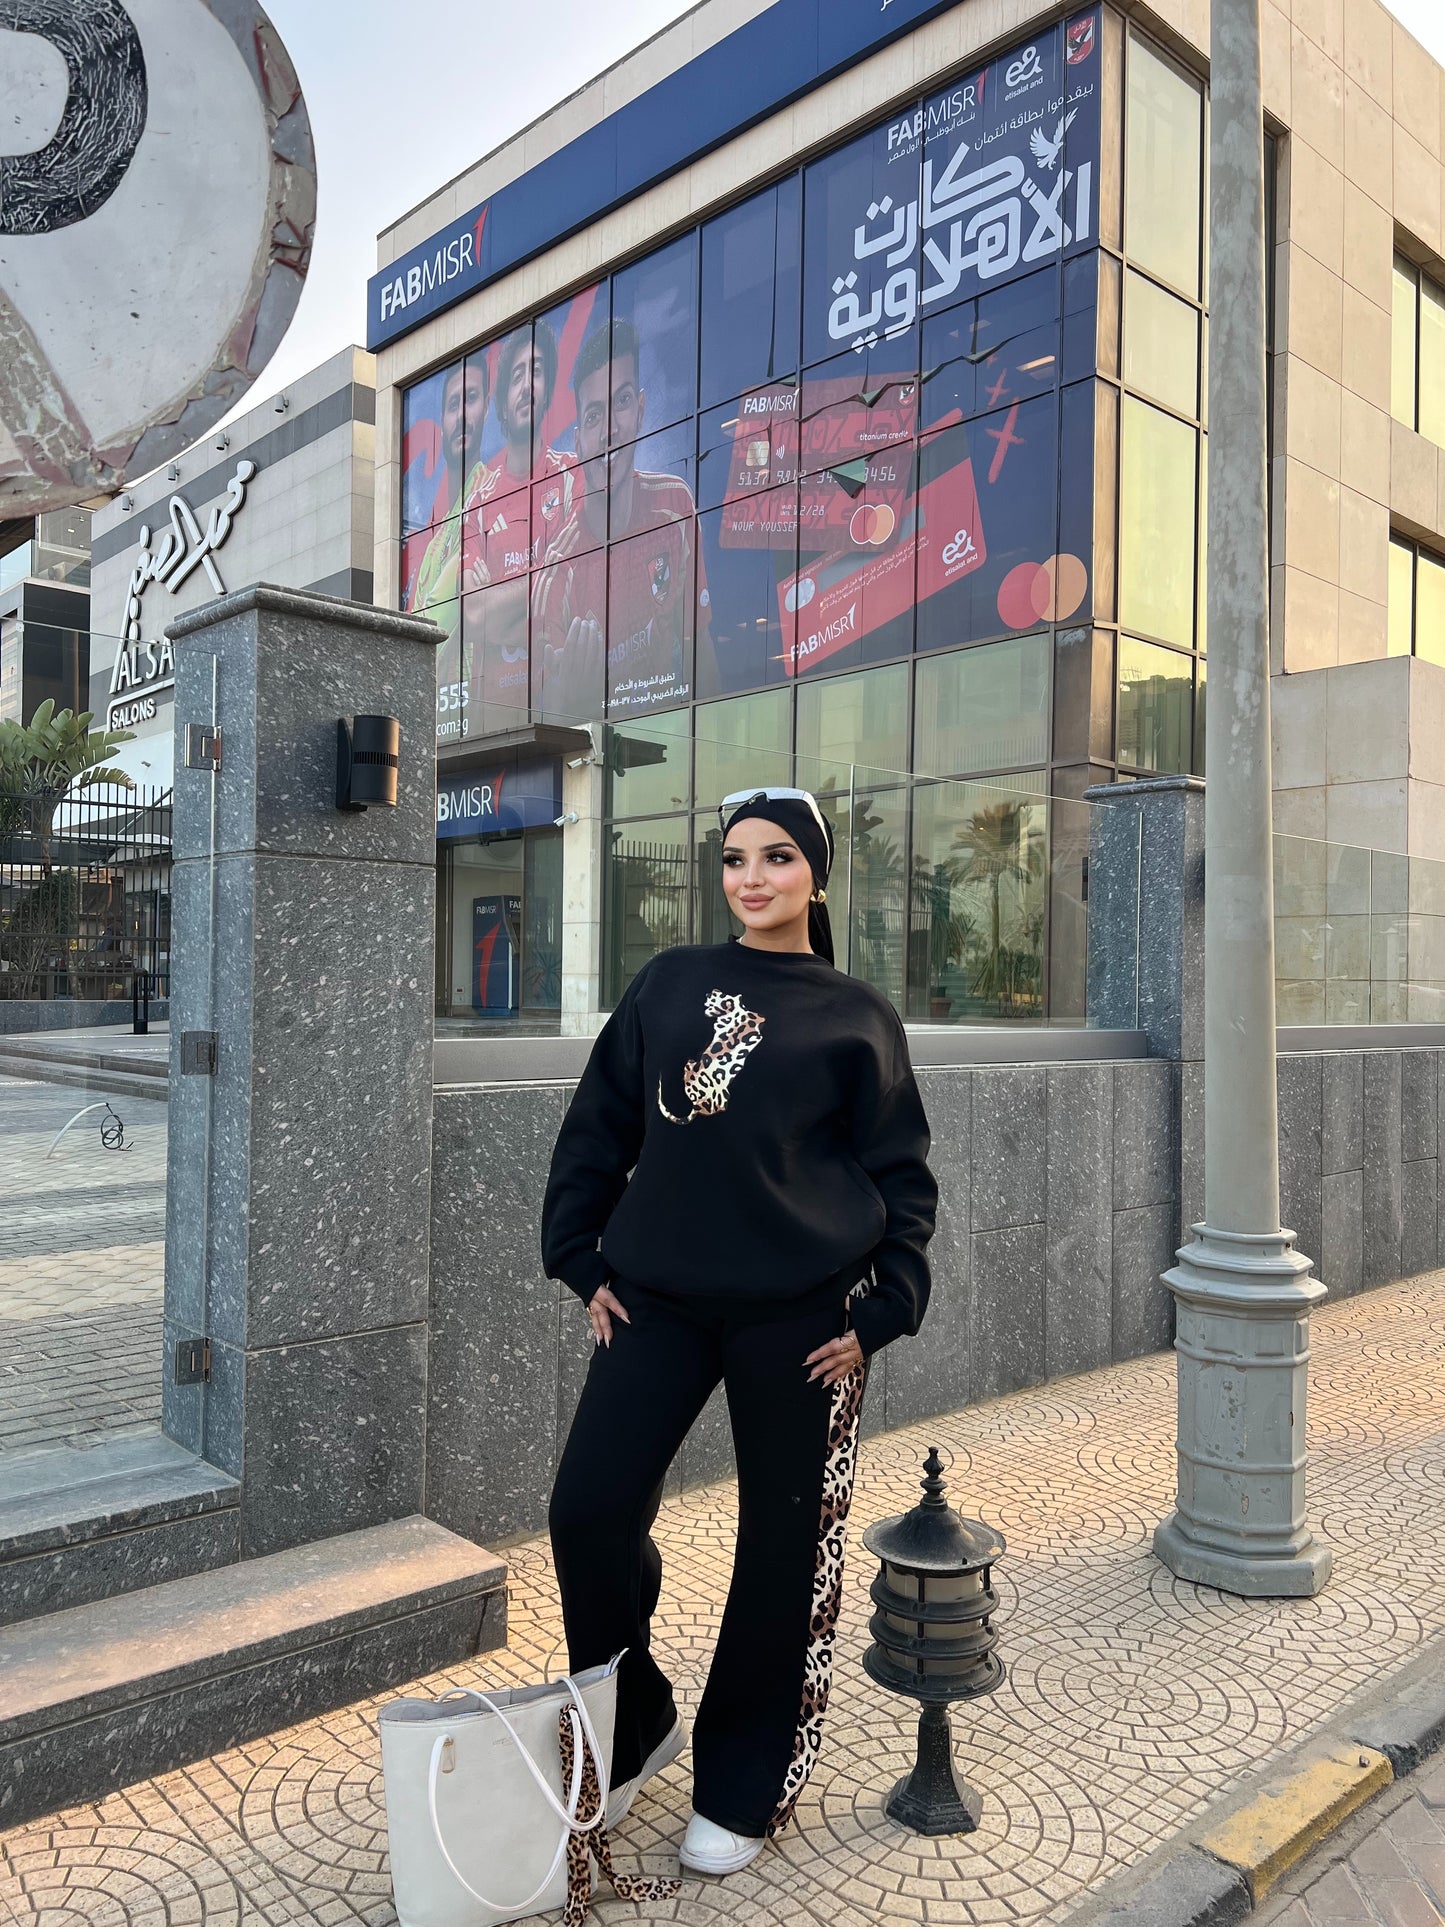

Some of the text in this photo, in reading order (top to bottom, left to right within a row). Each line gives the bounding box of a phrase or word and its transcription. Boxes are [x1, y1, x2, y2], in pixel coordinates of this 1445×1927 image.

[1005, 75, 1044, 101] etisalat and
[888, 84, 976, 151] FABMISR
[1009, 107, 1044, 130] بطاقة
[974, 121, 1008, 151] ائتمان
[854, 142, 1025, 269] كارت
[828, 160, 1092, 354] الأهلاوية
[380, 232, 474, 322] FABMISR
[743, 394, 794, 414] FABMISR
[859, 432, 888, 441] titanium
[732, 521, 798, 532] NOUR YOUSSEF
[790, 615, 850, 662] FABMISR
[118, 634, 176, 691] AL SA
[437, 681, 469, 713] 555
[111, 698, 156, 729] SALONS
